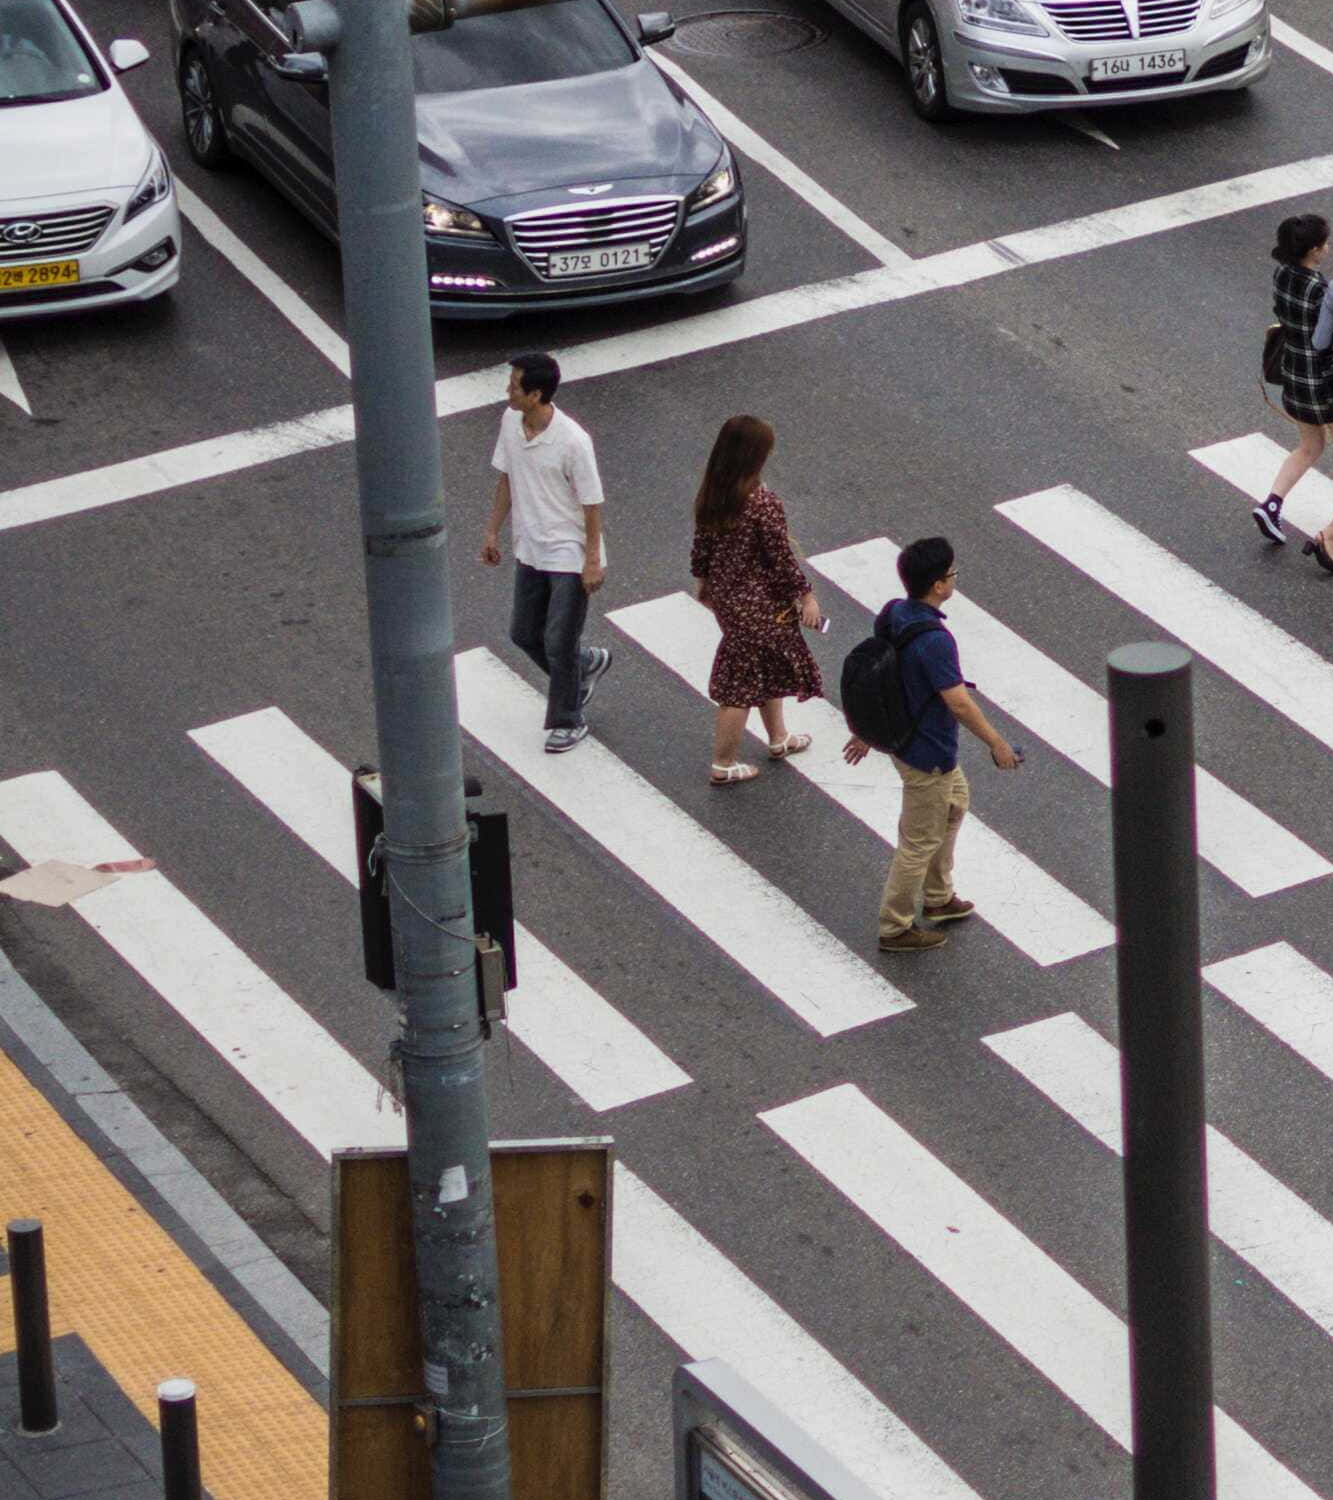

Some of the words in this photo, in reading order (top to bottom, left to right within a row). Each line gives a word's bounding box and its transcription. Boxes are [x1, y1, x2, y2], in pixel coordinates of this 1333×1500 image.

[1138, 53, 1177, 71] 1436
[599, 248, 641, 268] 0121
[28, 264, 72, 284] 2894
